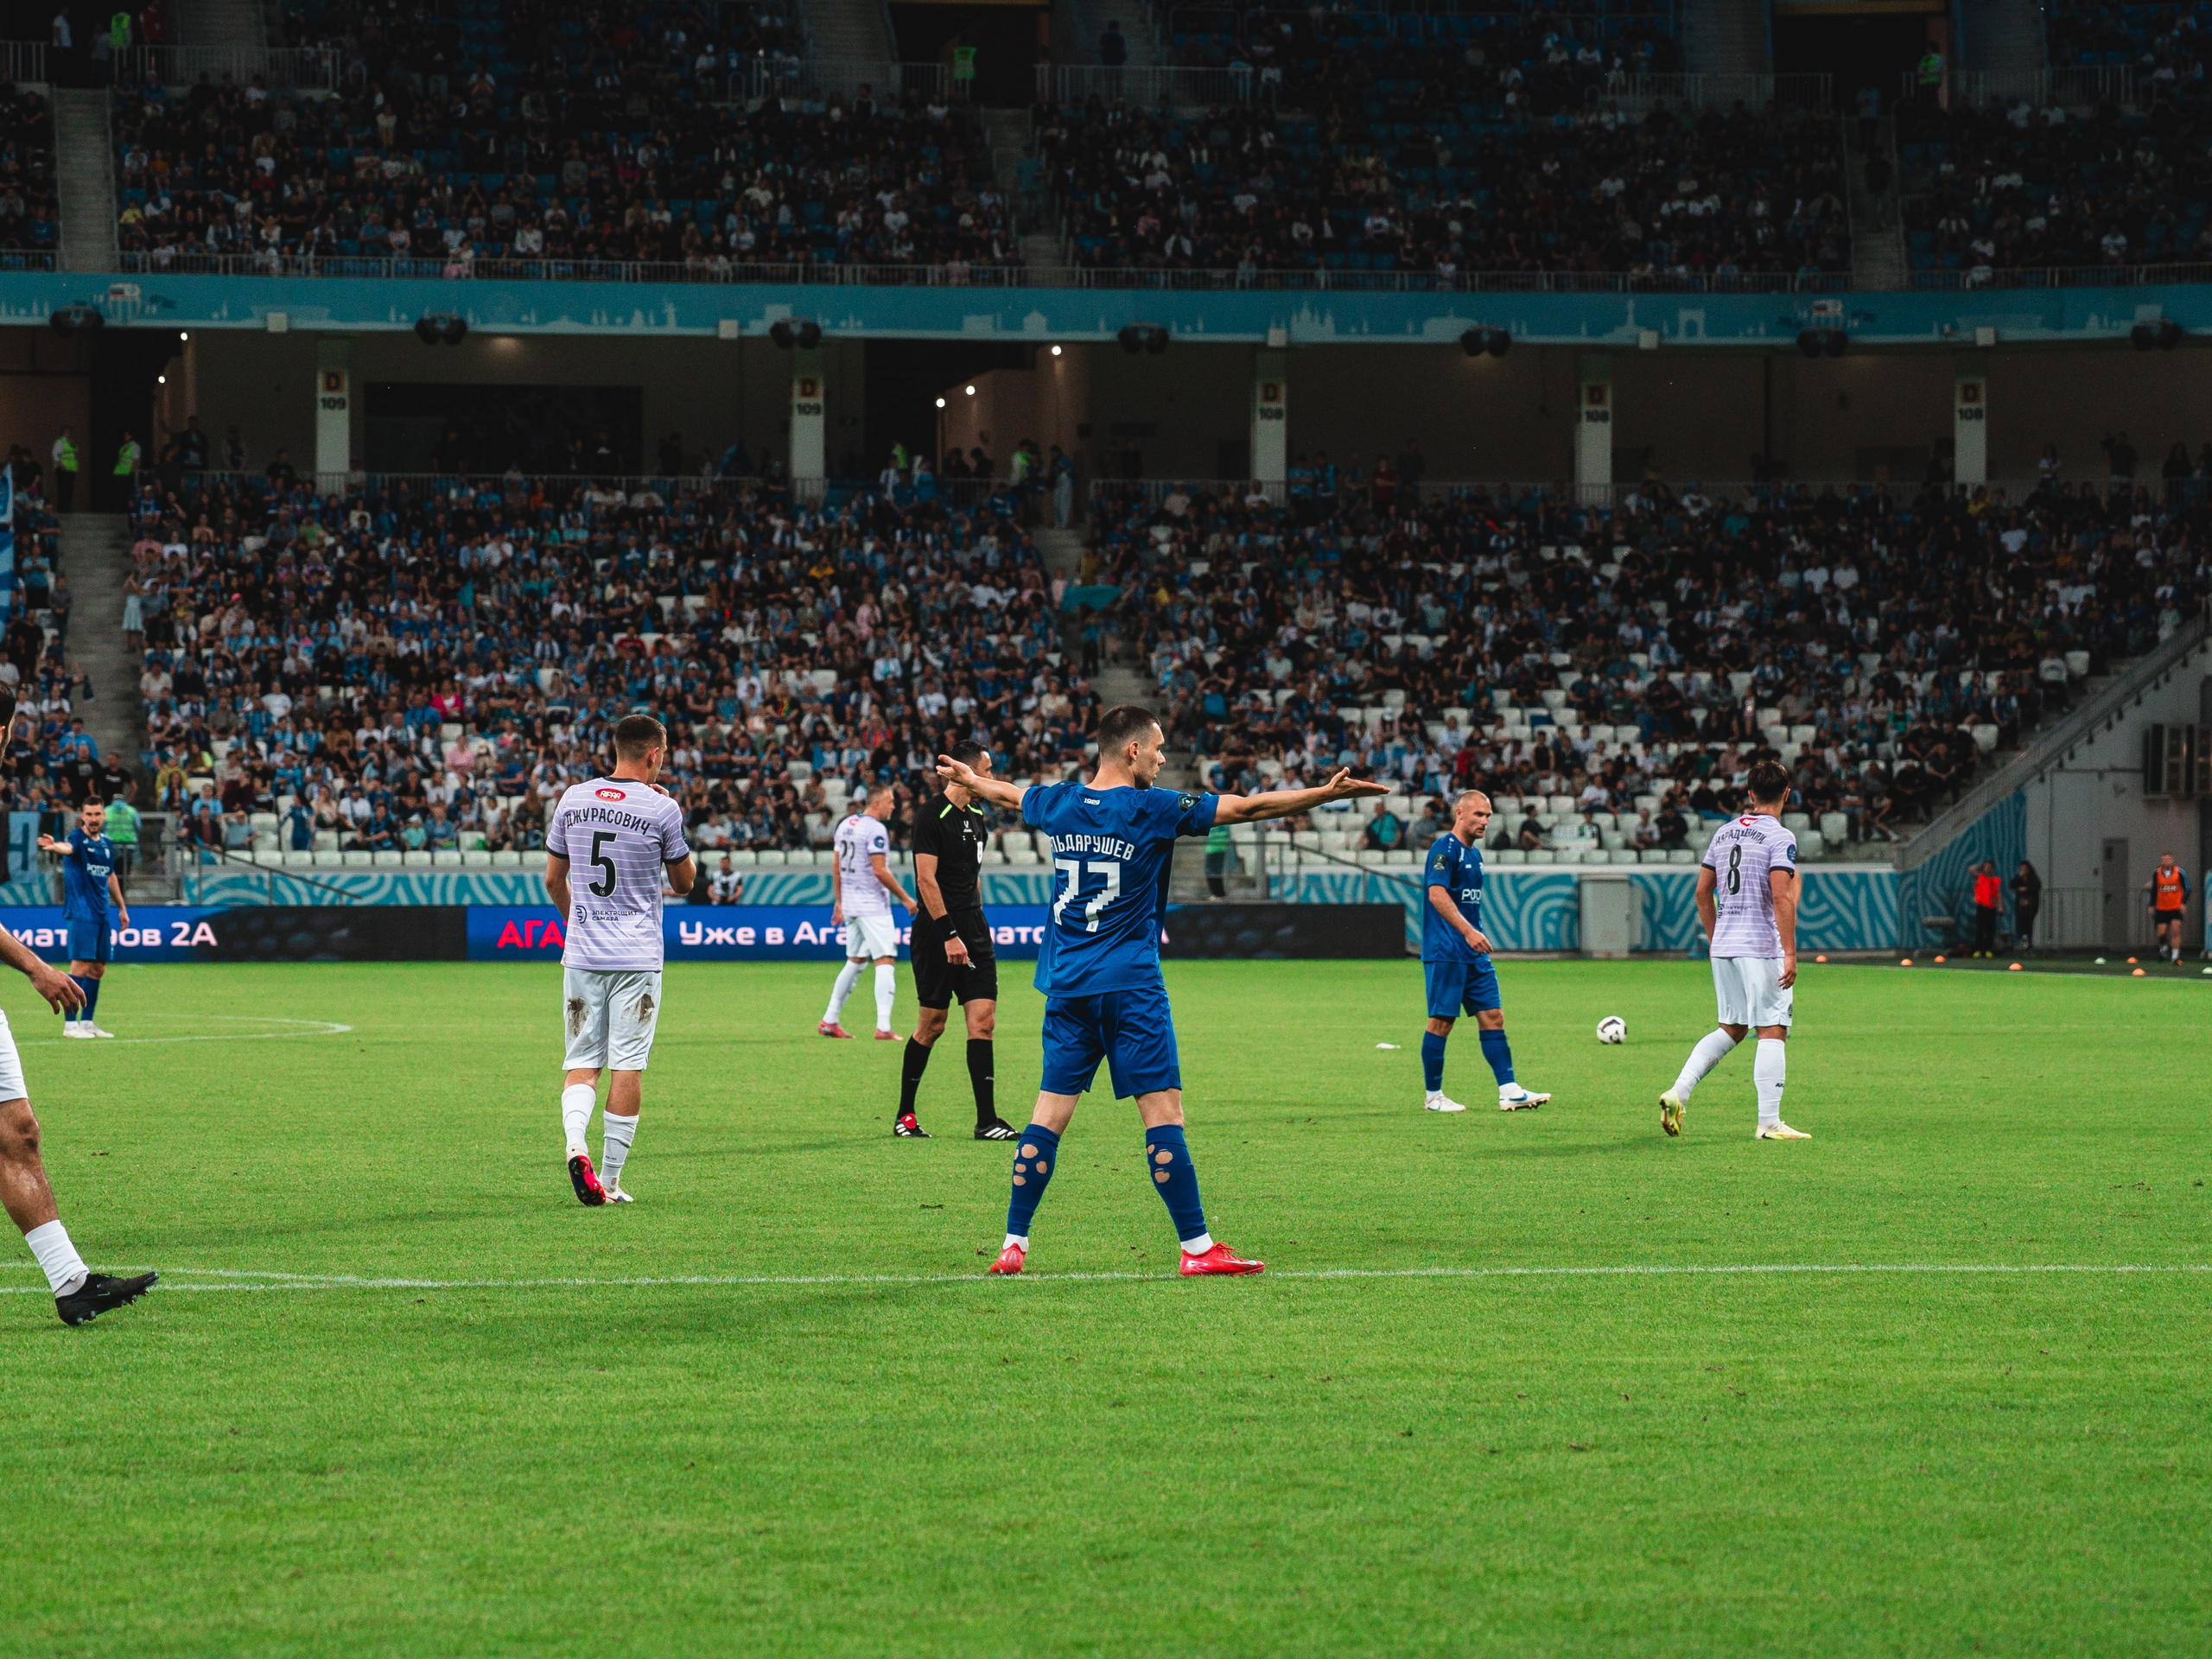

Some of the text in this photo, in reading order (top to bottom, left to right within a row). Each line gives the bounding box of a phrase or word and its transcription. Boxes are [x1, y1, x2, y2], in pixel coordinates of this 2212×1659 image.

[327, 372, 340, 390] D
[802, 379, 815, 397] D
[1265, 383, 1278, 400] D
[1963, 385, 1976, 403] D
[321, 397, 346, 410] 109
[1590, 386, 1603, 404] D
[565, 807, 651, 836] ДЖУРАСОВИЧ
[840, 840, 855, 873] 22
[1051, 834, 1135, 861] ЛЬДАРУШЕВ
[588, 830, 618, 898] 5
[1727, 843, 1742, 895] 8
[1053, 858, 1121, 932] 77
[170, 921, 218, 947] 2А
[497, 920, 567, 949] АГА
[679, 921, 756, 945] Уже
[765, 927, 785, 945] в
